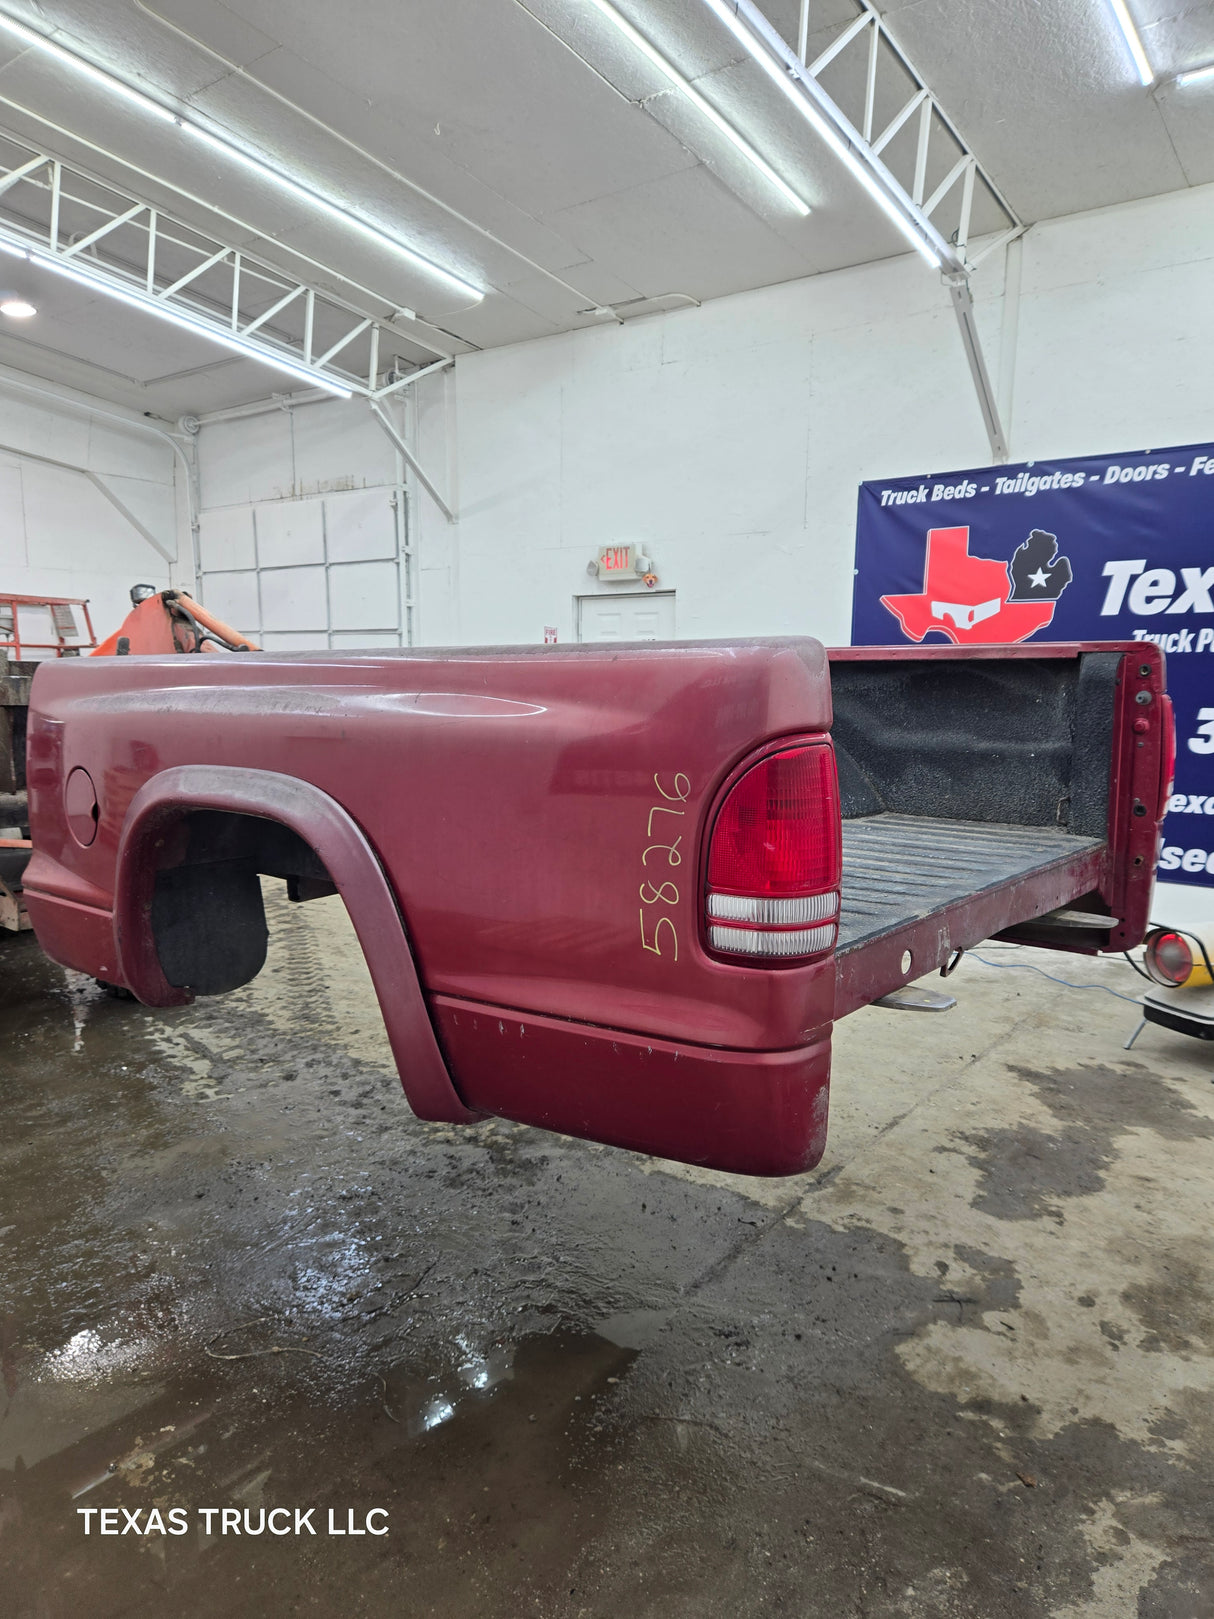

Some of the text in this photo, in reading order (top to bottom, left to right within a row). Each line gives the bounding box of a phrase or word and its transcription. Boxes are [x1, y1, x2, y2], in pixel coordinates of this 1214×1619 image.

[880, 485, 930, 506] Truck
[931, 480, 977, 501] Beds
[994, 471, 1086, 497] Tailgates
[1103, 463, 1171, 485] Doors
[605, 546, 631, 570] EXIT
[1100, 559, 1214, 616] Tex
[639, 772, 691, 962] 58276
